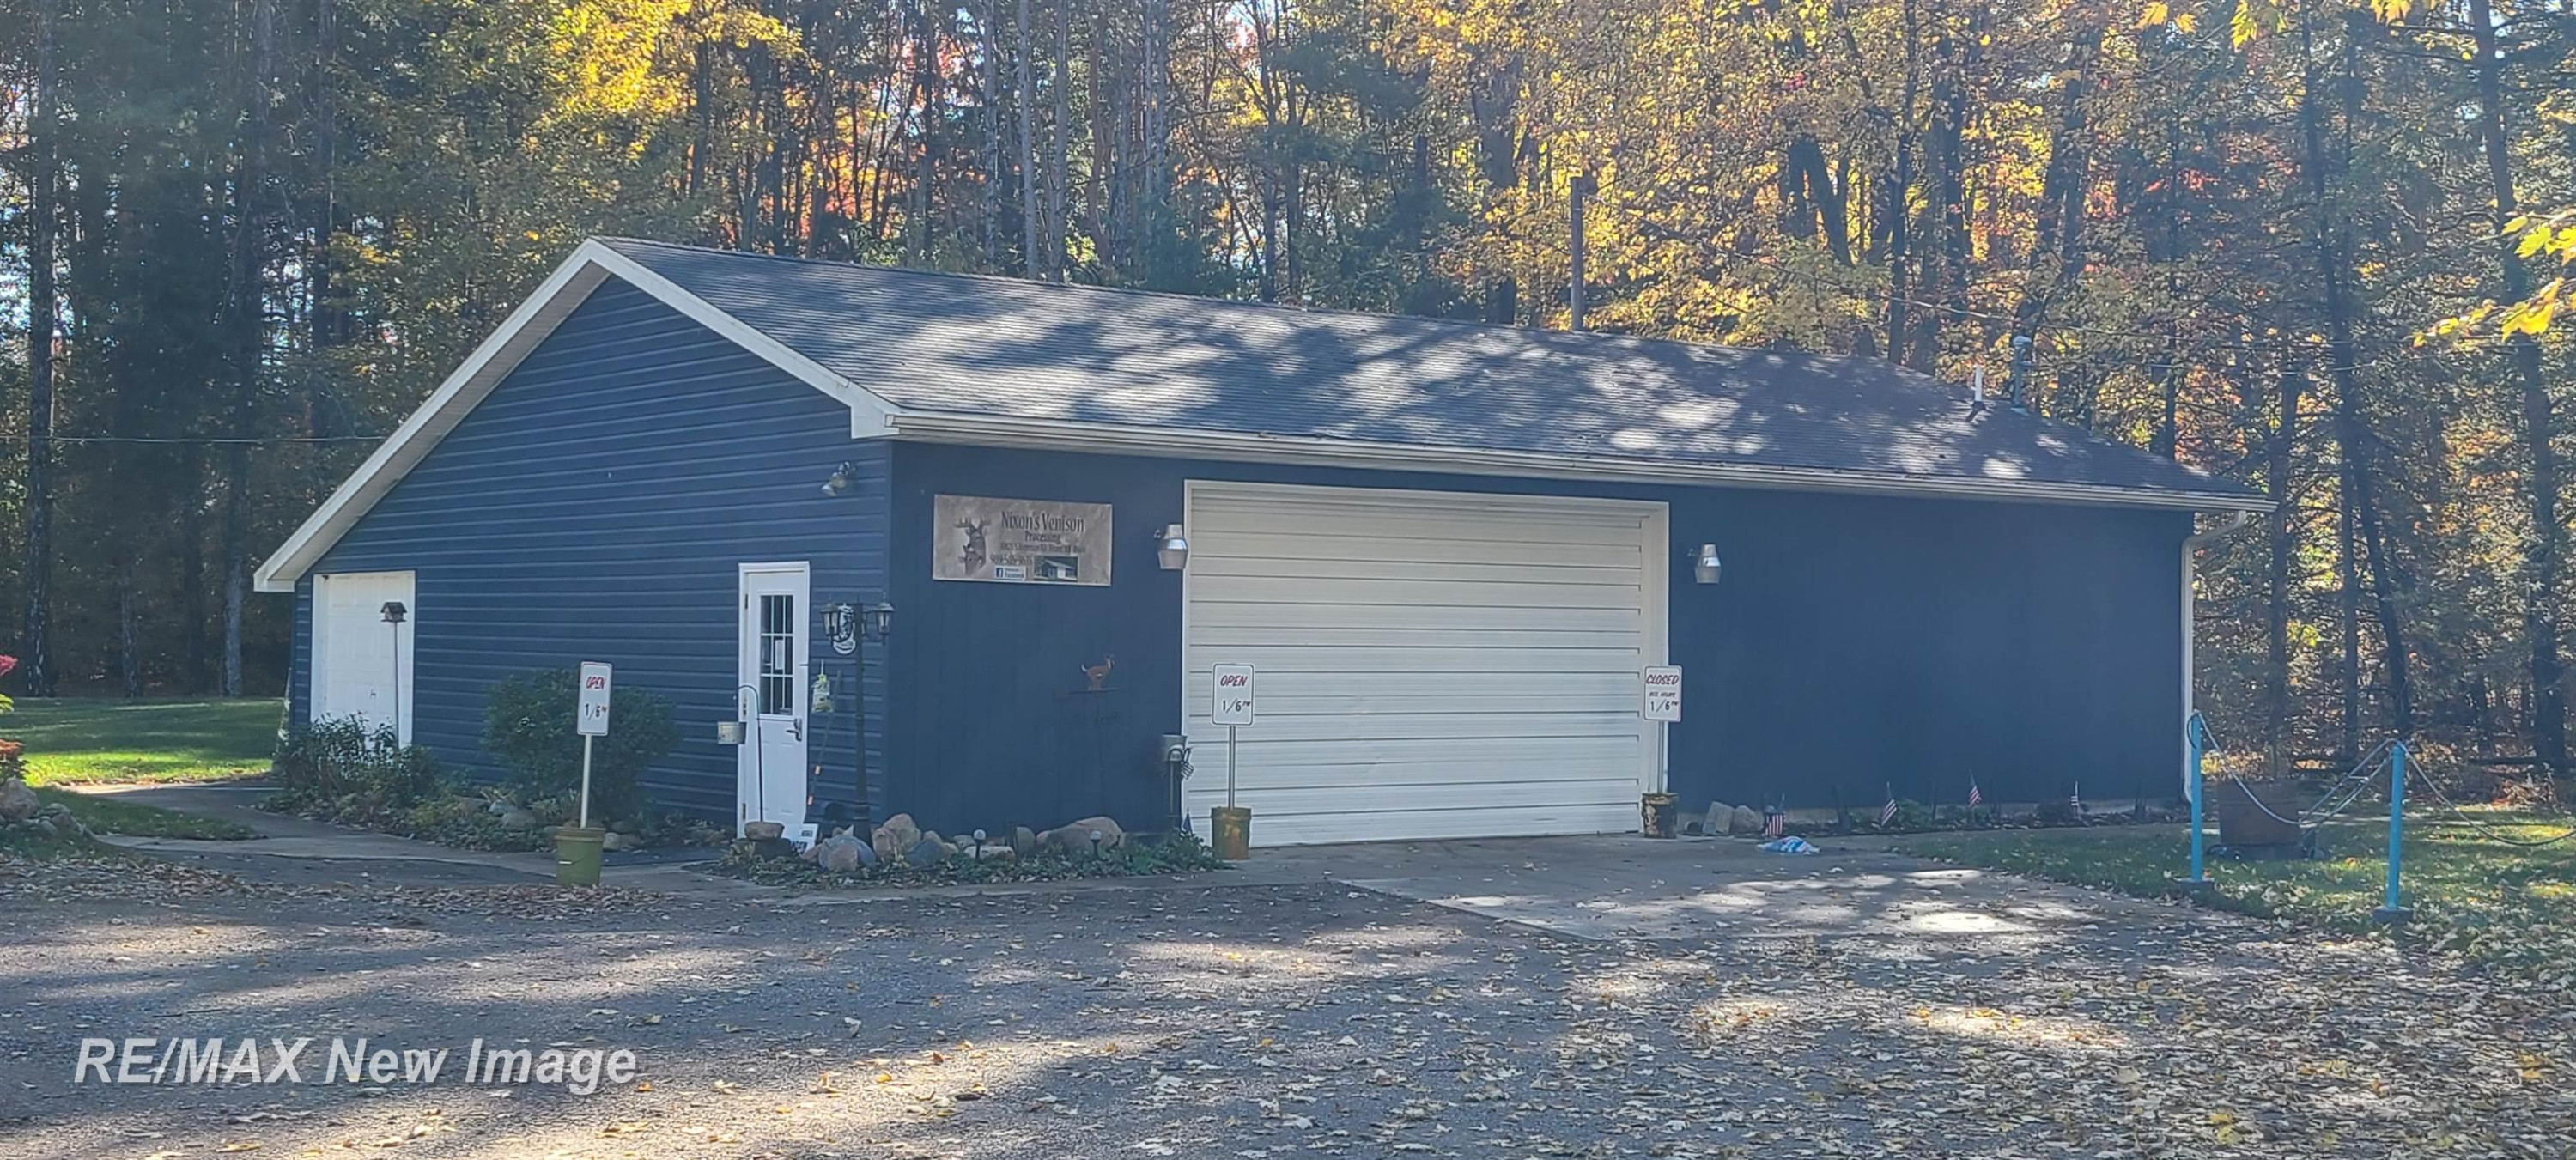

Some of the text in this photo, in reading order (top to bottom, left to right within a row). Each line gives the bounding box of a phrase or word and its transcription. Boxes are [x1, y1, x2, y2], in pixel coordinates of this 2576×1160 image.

[1001, 511, 1084, 533] Nixon's Venison
[1024, 530, 1061, 544] Processing
[586, 676, 606, 689] OPEN
[1220, 675, 1248, 686] OPEN
[1646, 674, 1679, 685] CLOSED
